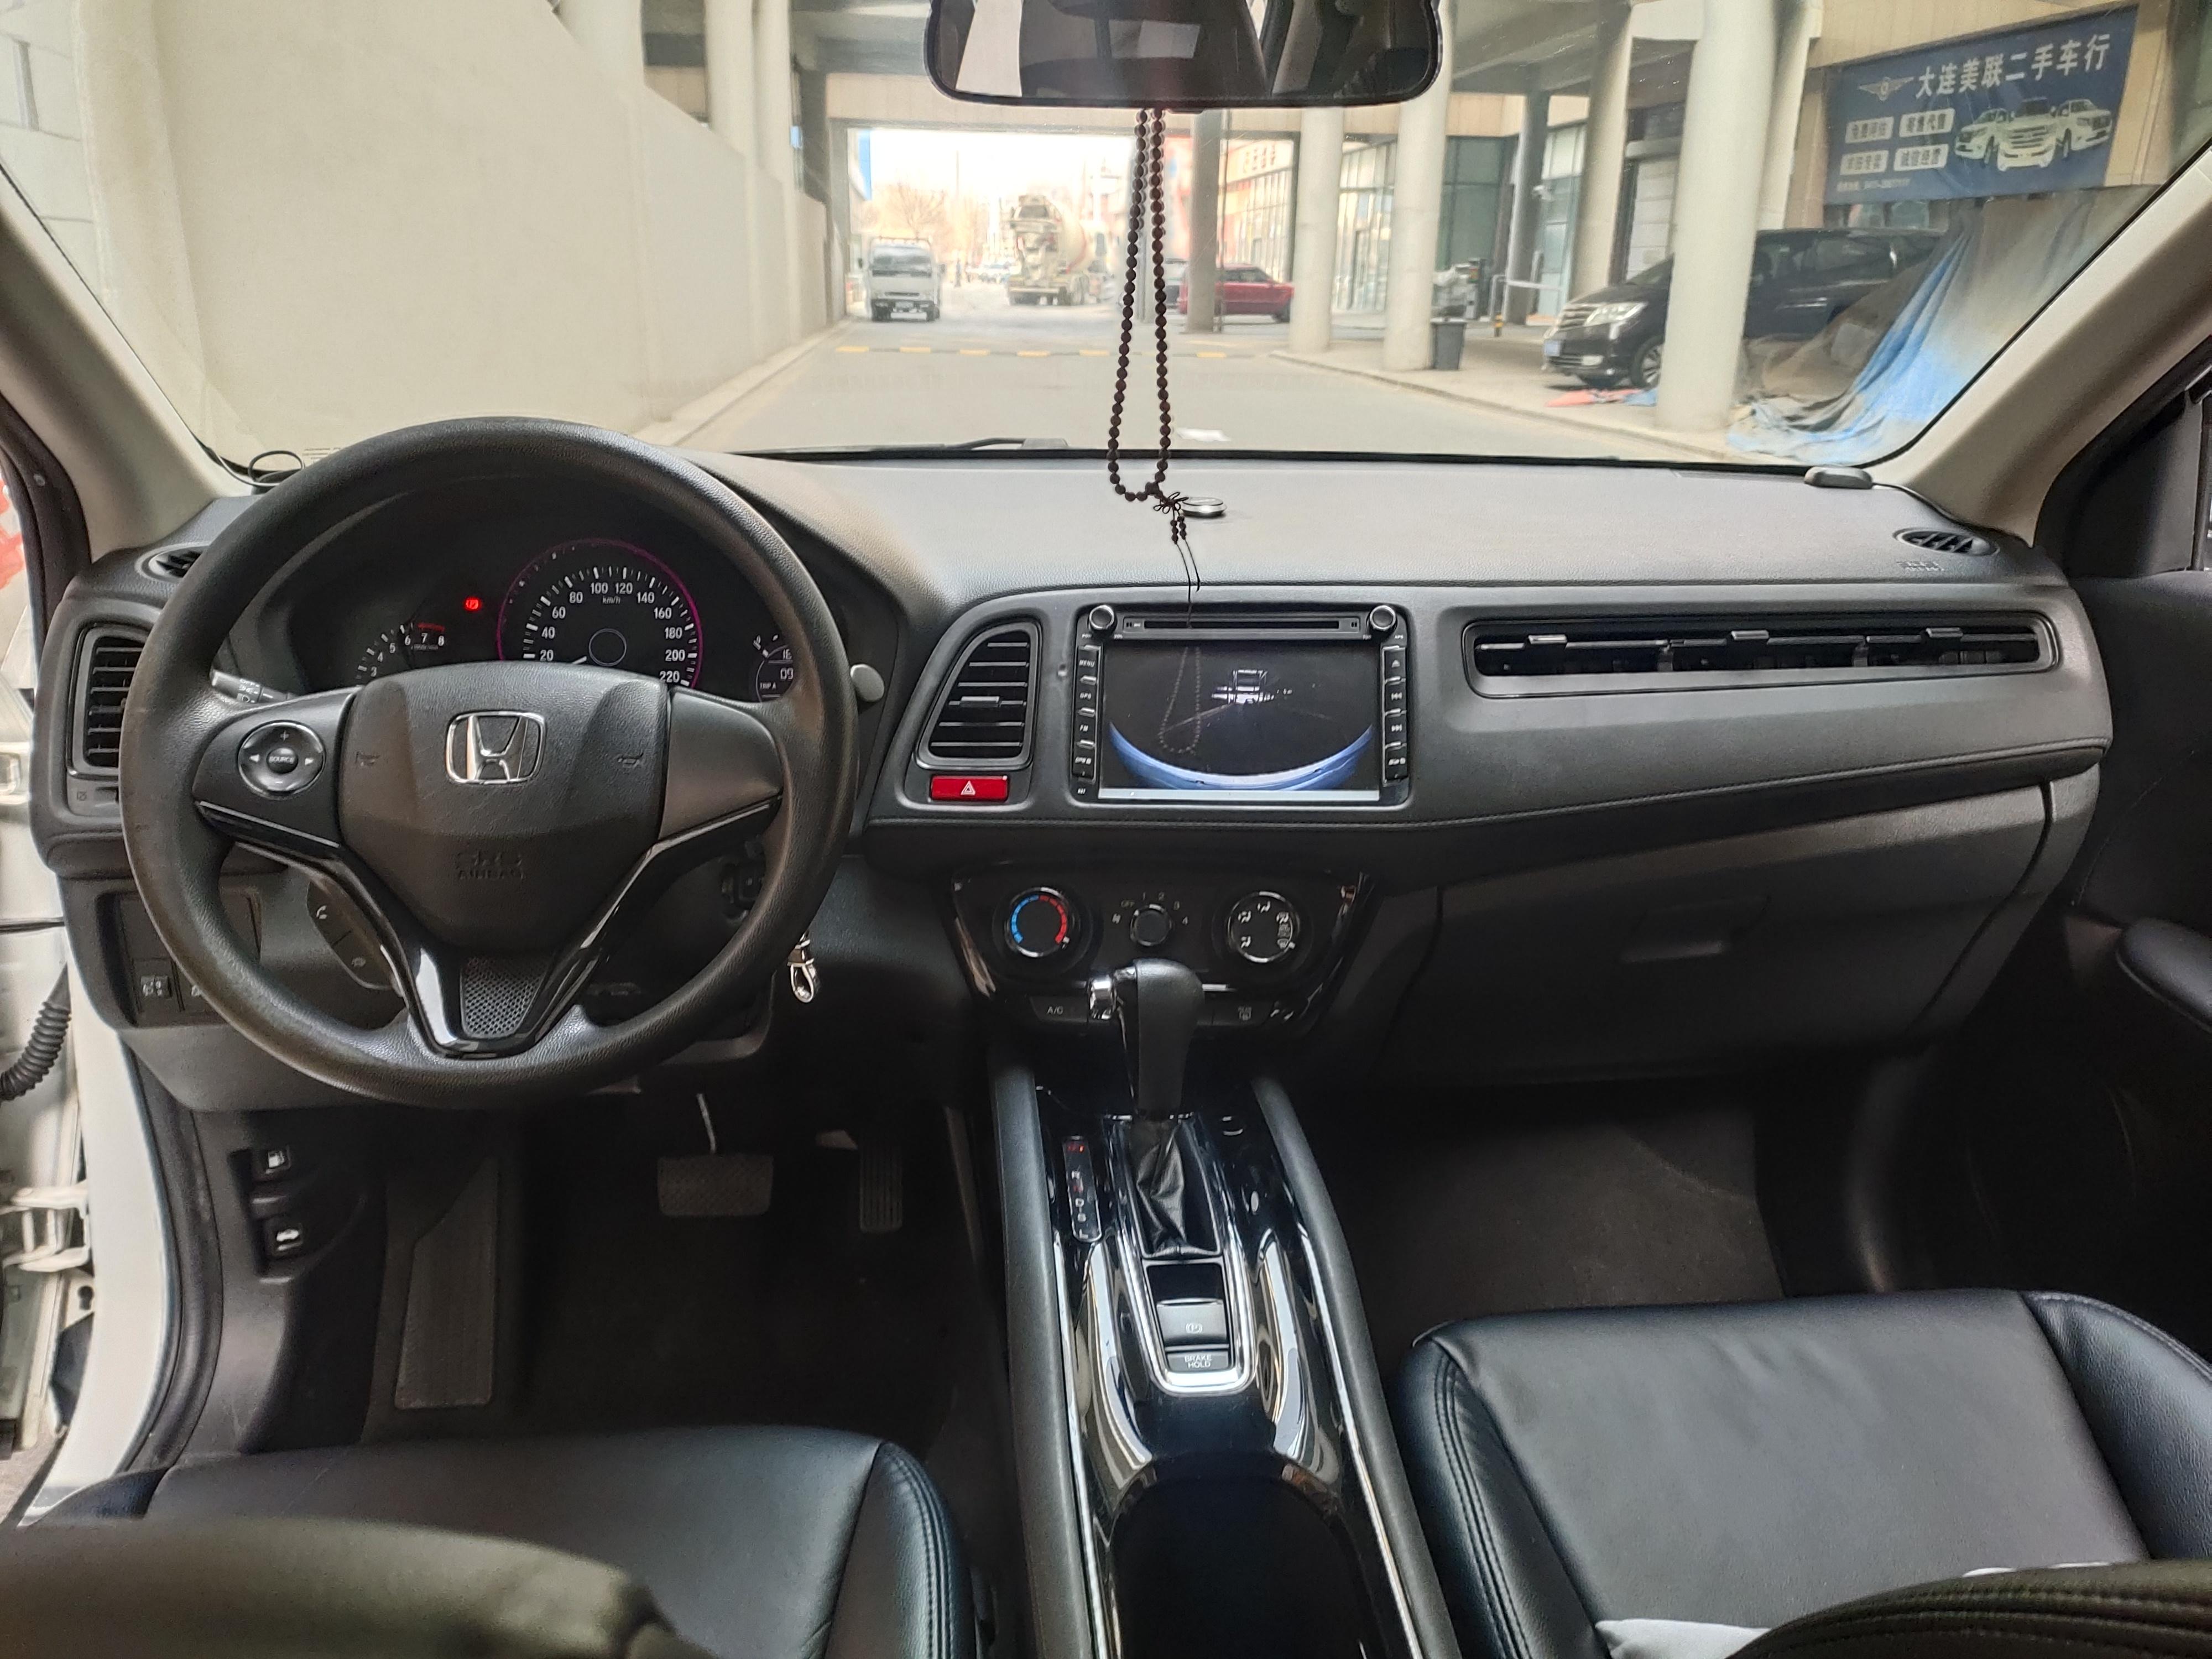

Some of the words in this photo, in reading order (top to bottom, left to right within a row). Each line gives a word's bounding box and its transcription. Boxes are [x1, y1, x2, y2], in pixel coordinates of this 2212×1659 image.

[1916, 34, 2110, 98] 大连美联二手车行
[590, 582, 608, 594] 100
[615, 582, 633, 594] 120
[569, 592, 583, 603] 80
[602, 596, 620, 604] km/h
[637, 592, 655, 603] 140
[552, 607, 566, 619] 60
[654, 607, 672, 619] 160
[421, 633, 428, 643] 7
[541, 627, 555, 639] 40
[664, 627, 682, 639] 180
[405, 635, 411, 645] 6
[438, 635, 444, 646] 8
[389, 643, 396, 654] 5
[378, 651, 384, 662] 4
[540, 649, 554, 661] 20
[665, 649, 686, 661] 200
[371, 666, 377, 677] 3
[659, 670, 680, 683] 220
[1182, 916, 1188, 925] 4
[1047, 1006, 1063, 1015] A/C
[1079, 1228, 1089, 1239] L
[1185, 1354, 1213, 1363] BRAKE
